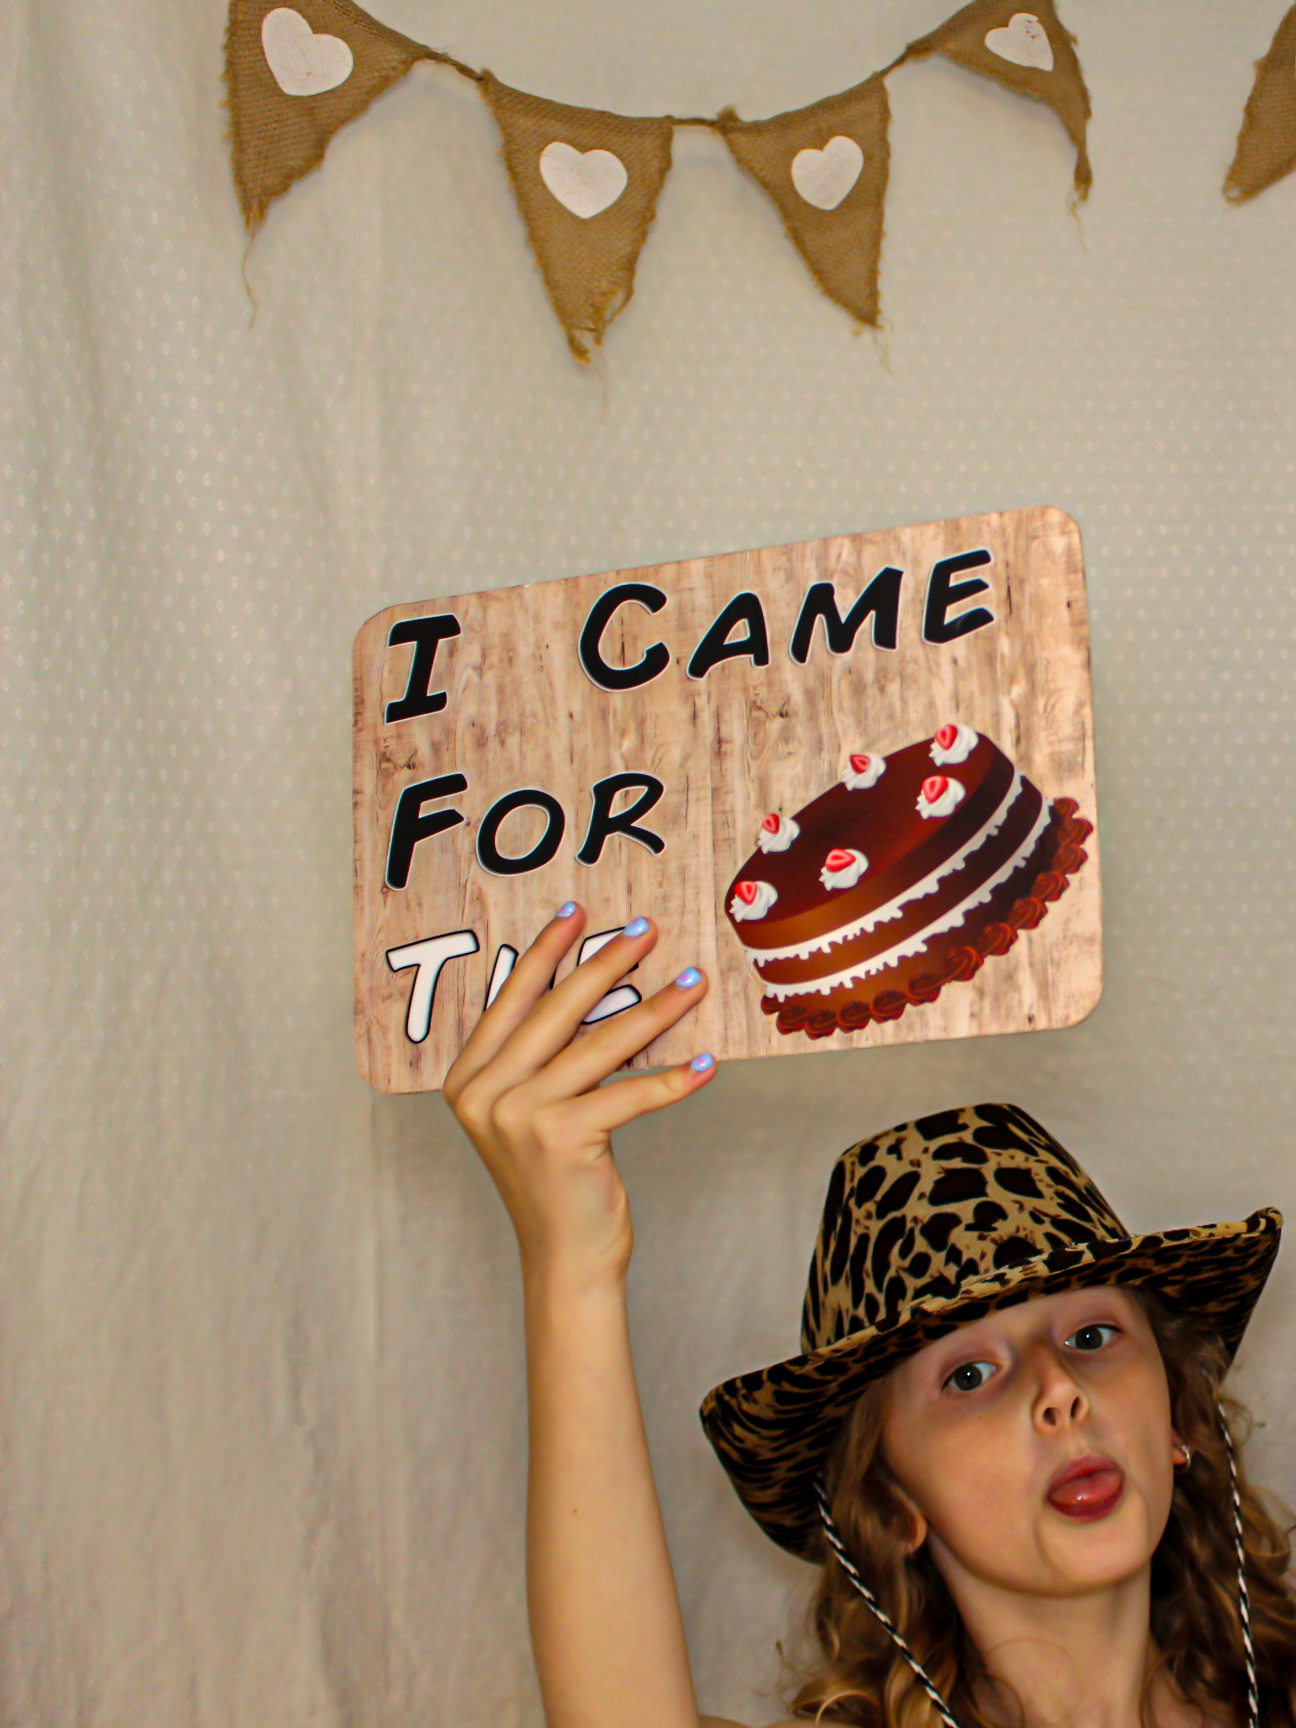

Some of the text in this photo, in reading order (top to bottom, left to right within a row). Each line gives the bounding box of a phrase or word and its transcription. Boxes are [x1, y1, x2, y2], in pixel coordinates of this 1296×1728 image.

[385, 549, 994, 724] I CAME
[385, 772, 666, 891] FOR
